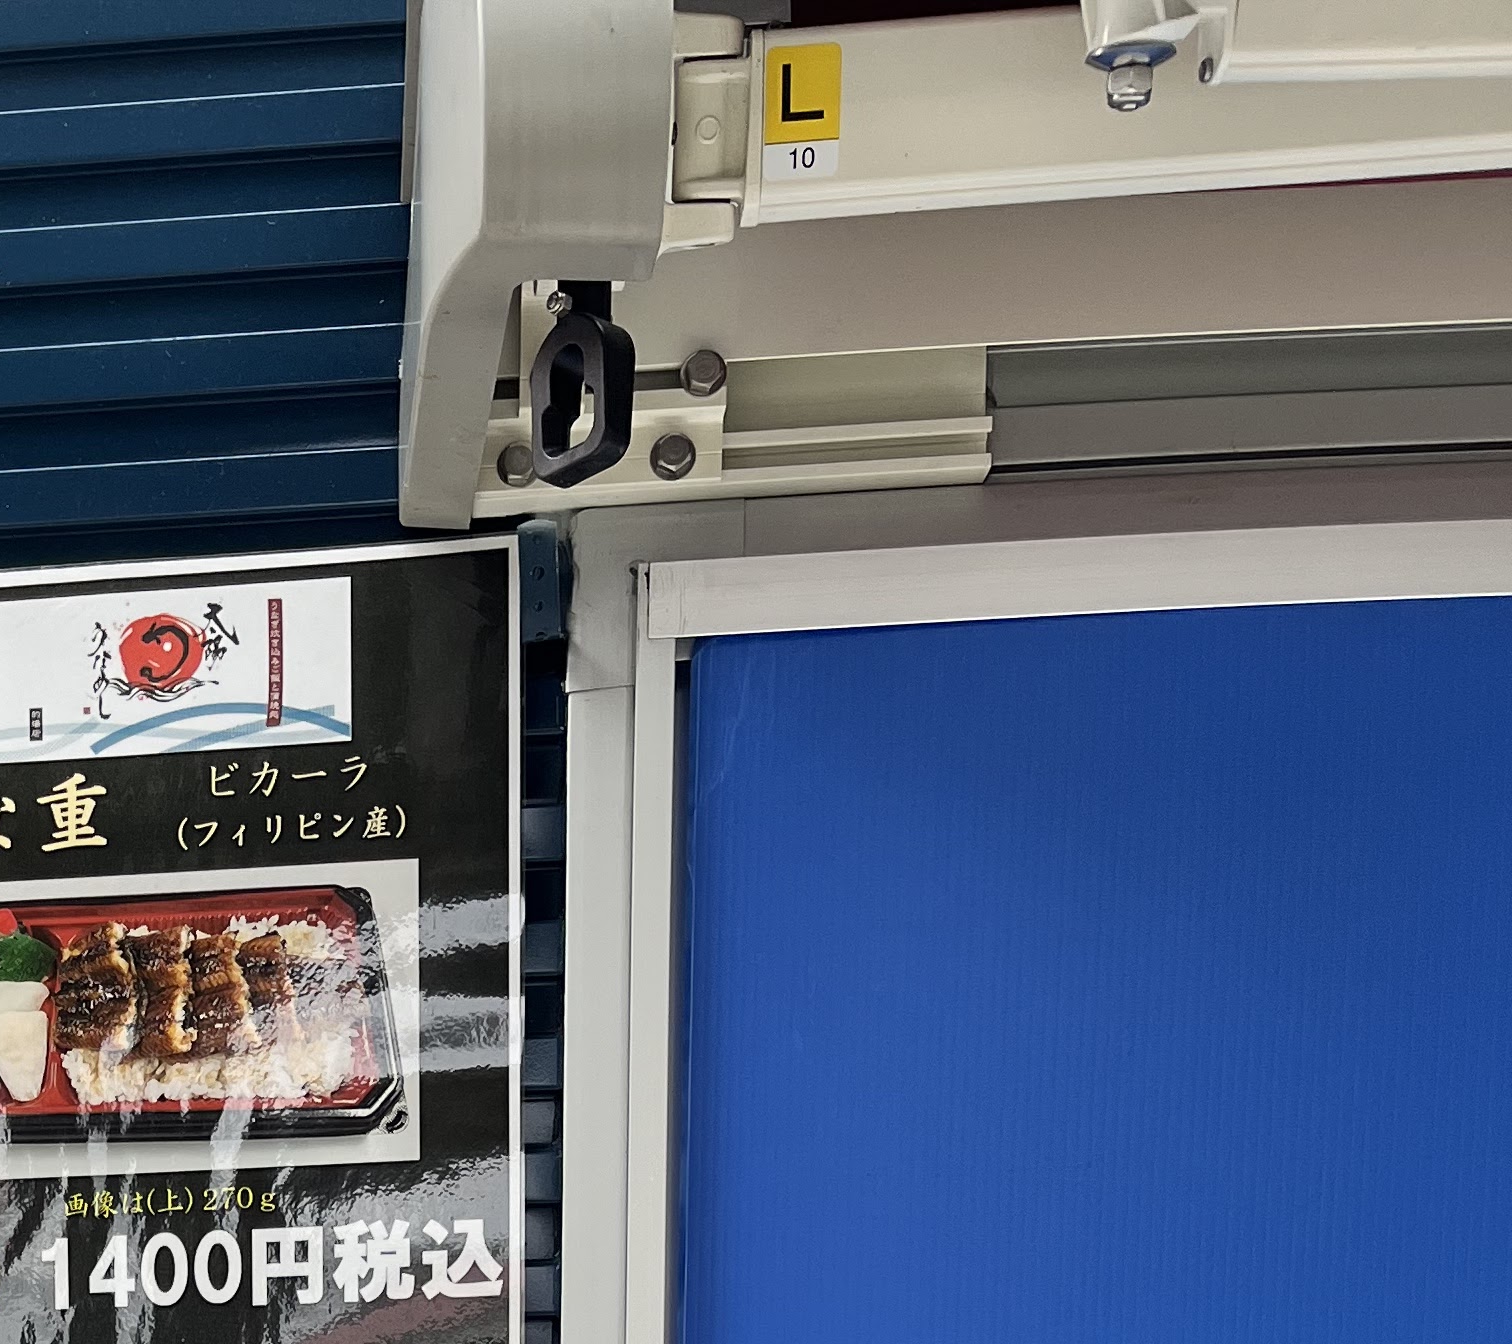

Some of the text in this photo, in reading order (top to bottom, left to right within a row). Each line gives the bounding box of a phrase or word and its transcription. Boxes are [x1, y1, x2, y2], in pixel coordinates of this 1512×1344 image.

[781, 63, 825, 123] L
[787, 146, 816, 170] 10
[207, 755, 370, 798] ビカーラ
[177, 803, 408, 852] (フィリピン産)
[40, 1218, 504, 1311] 1400円税込
